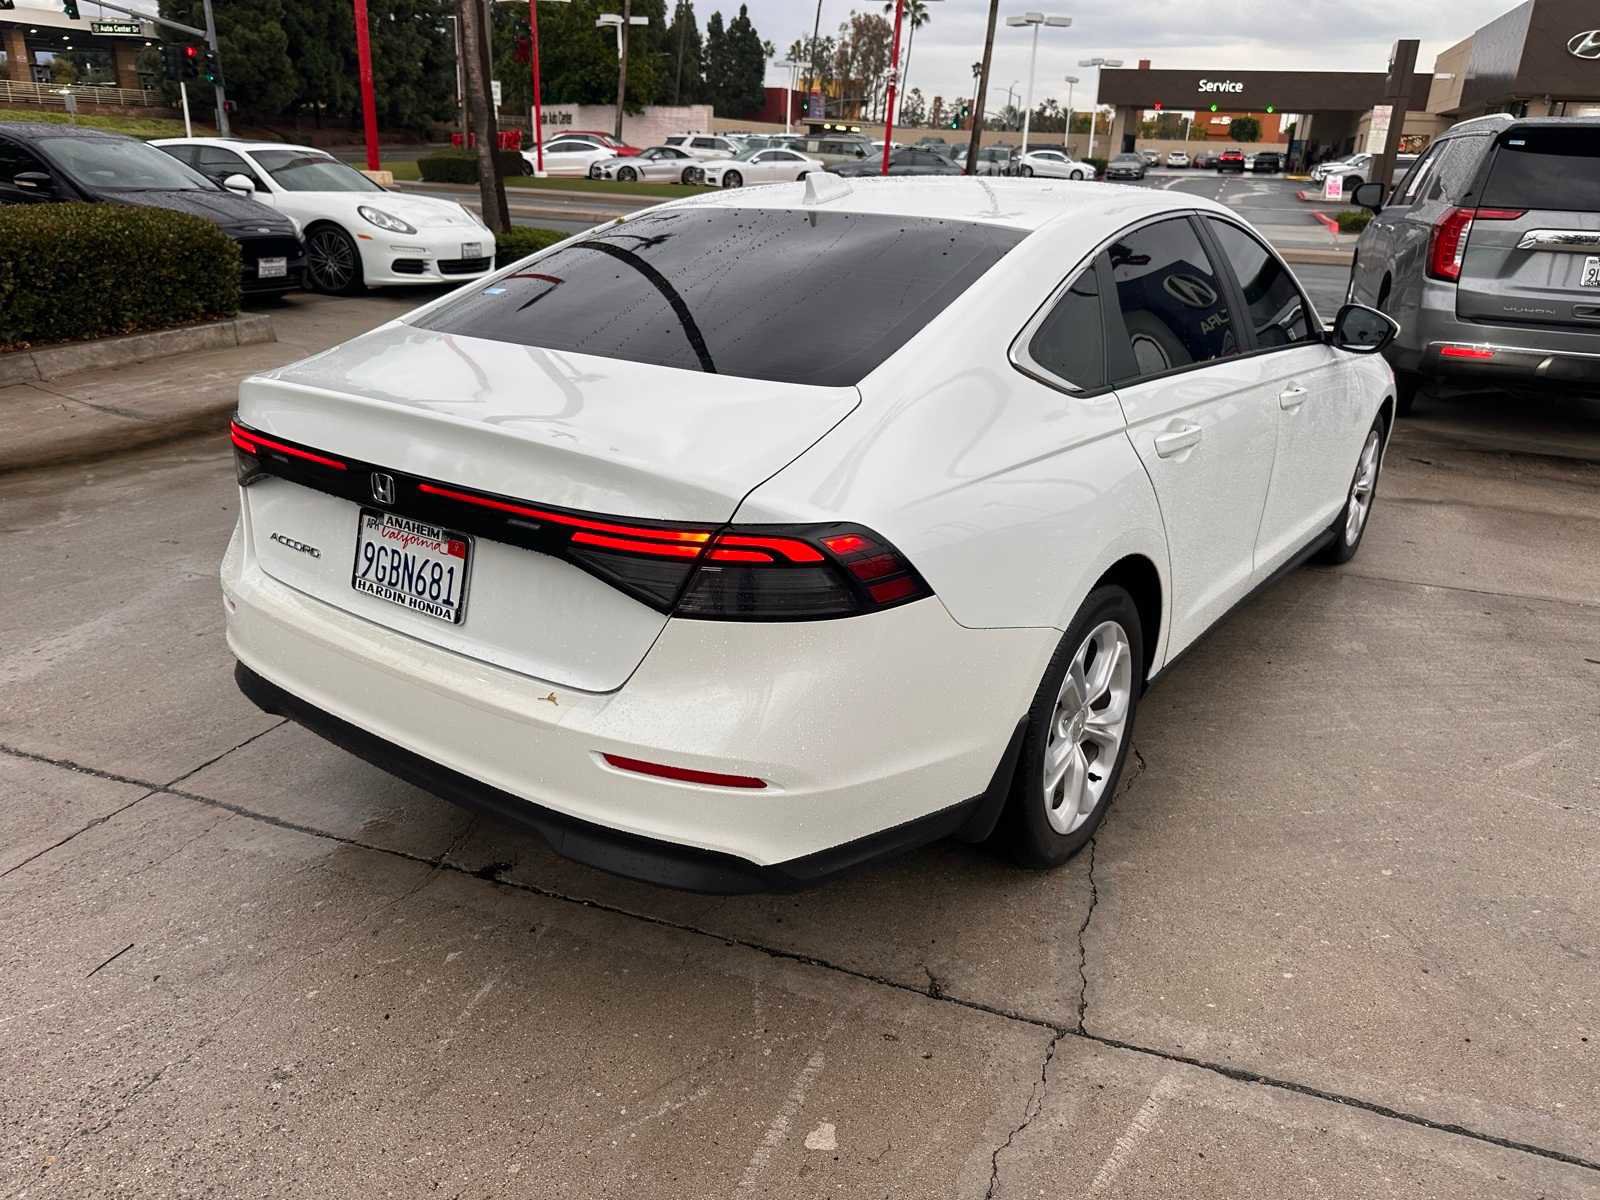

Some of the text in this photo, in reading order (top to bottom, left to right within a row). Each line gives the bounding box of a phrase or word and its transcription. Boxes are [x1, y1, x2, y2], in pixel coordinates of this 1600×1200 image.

[1198, 79, 1244, 93] Service
[381, 526, 449, 556] California
[386, 516, 441, 540] ANAHEIM
[270, 532, 321, 559] ACCORD
[361, 541, 455, 606] 9GBN681
[358, 579, 452, 620] HARDIN HONDA
